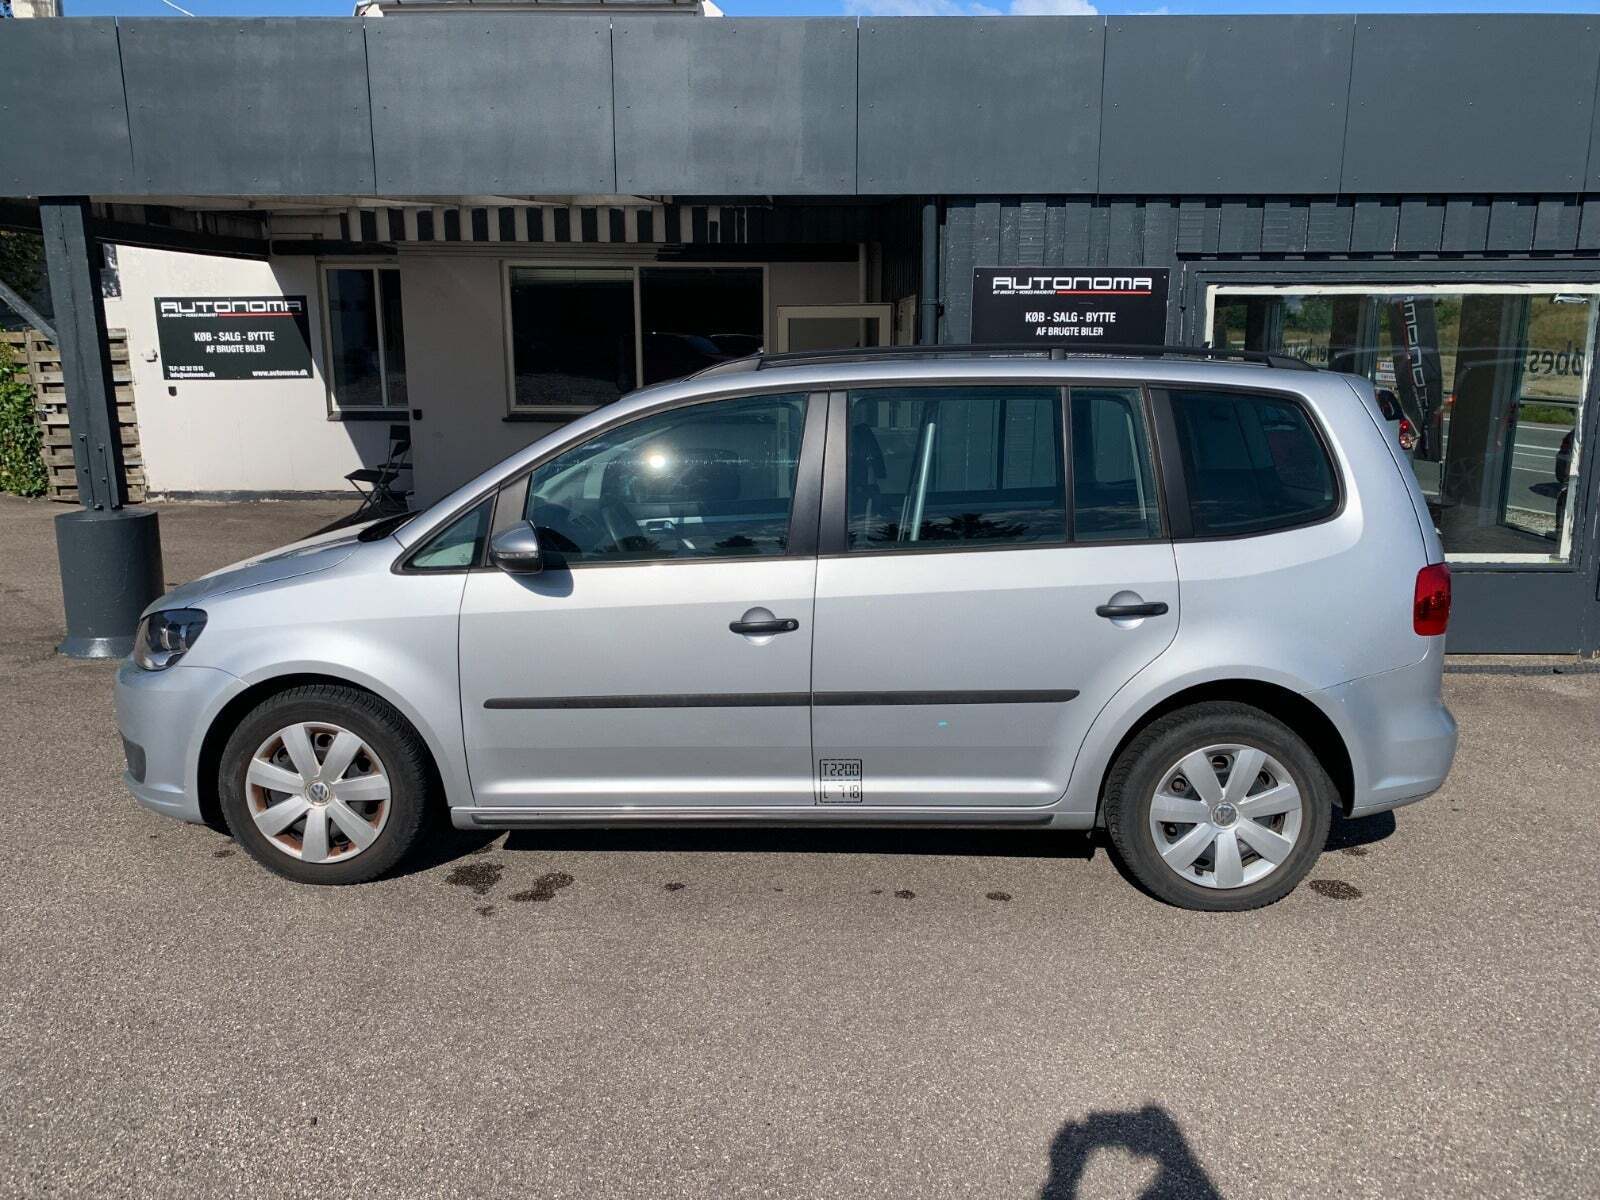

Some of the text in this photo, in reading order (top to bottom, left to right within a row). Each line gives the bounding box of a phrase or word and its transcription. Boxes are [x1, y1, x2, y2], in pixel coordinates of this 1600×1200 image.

[993, 277, 1153, 290] AUTONOMA
[160, 301, 302, 313] AUTONOMA
[1025, 312, 1045, 323] KØB
[1053, 312, 1078, 323] SALG
[1086, 312, 1116, 323] BYTTE
[194, 332, 213, 342] KØB
[218, 331, 241, 342] SALG
[247, 331, 275, 342] BYTTE
[1036, 327, 1104, 336] AF BRUGTE BILER
[206, 344, 266, 353] AF BRUGTE BILER
[252, 369, 309, 377] www.autonoma.dk
